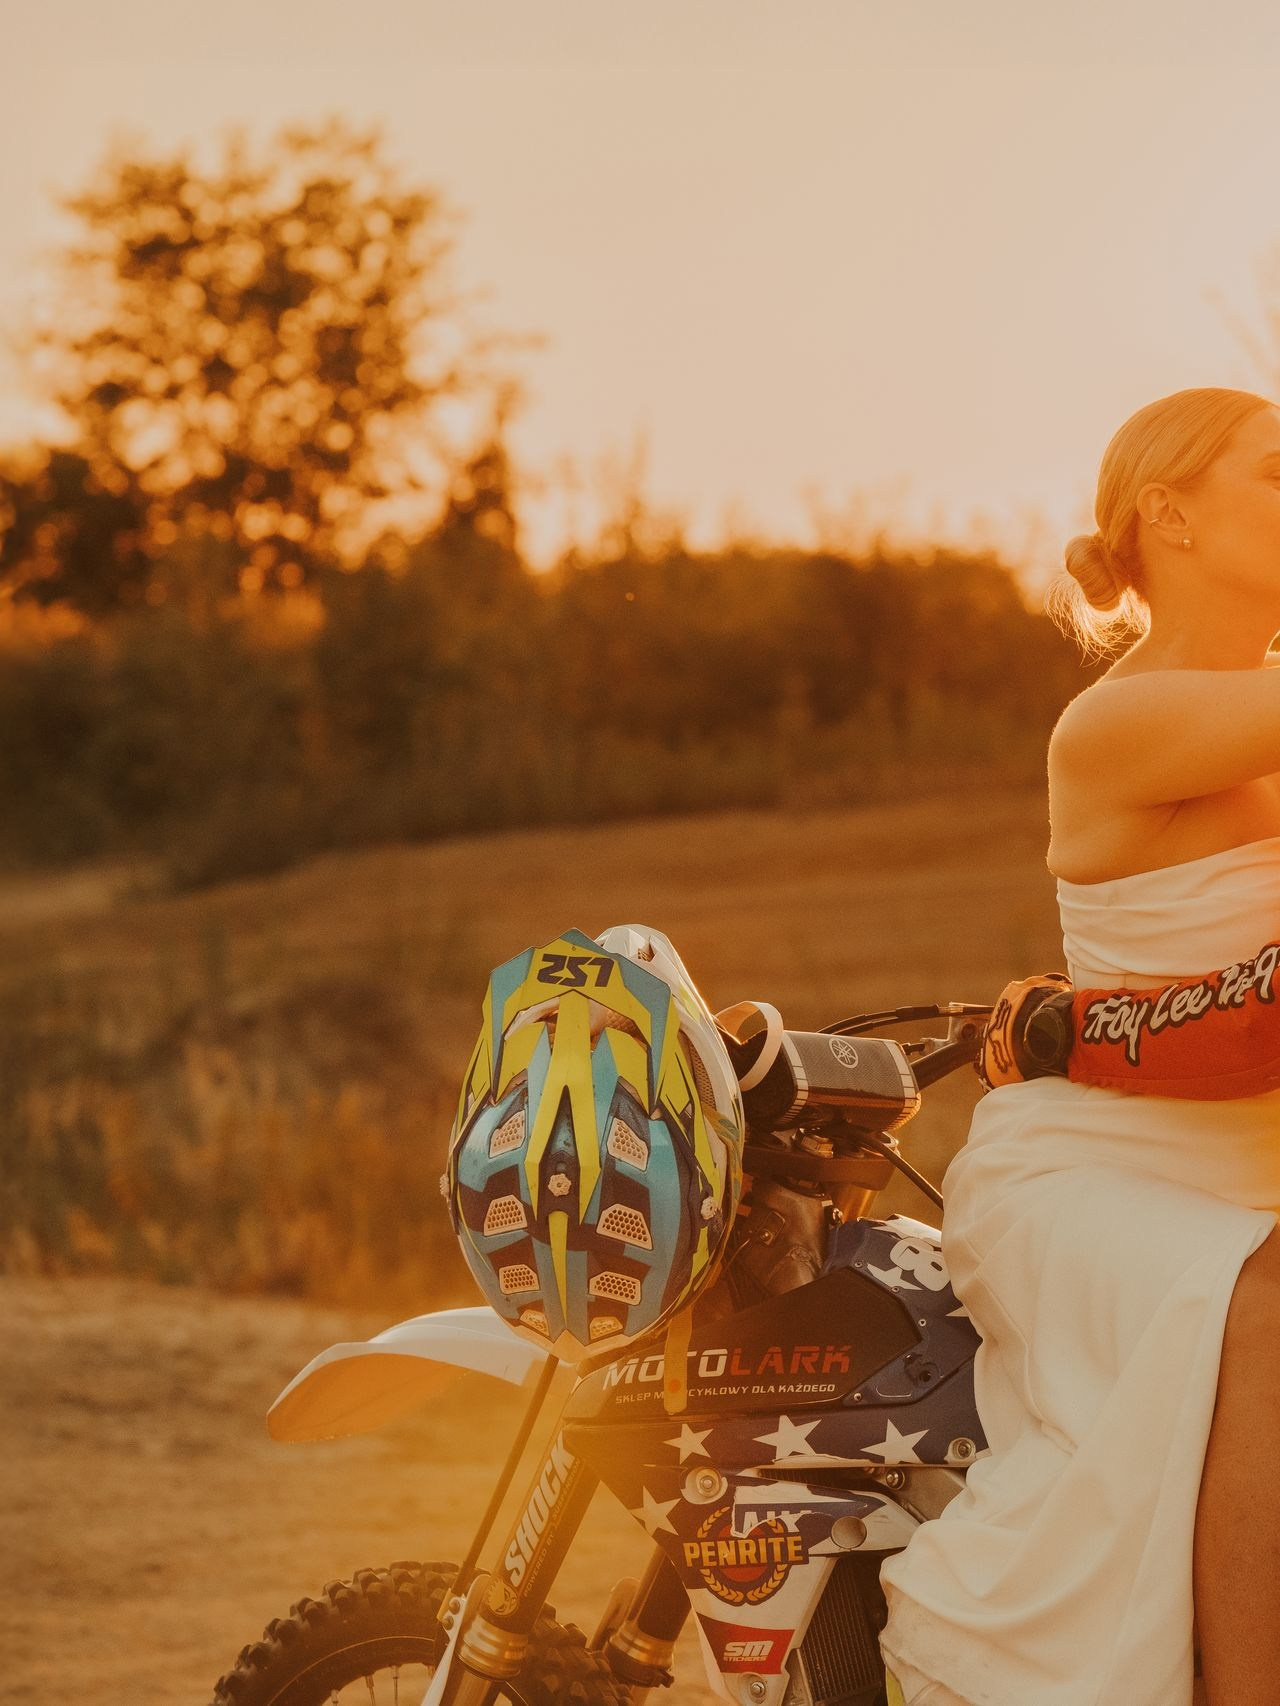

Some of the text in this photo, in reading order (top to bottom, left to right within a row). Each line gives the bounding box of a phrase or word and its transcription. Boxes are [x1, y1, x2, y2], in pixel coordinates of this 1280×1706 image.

[536, 953, 615, 988] 257
[1149, 985, 1213, 1030] Lee
[602, 1345, 852, 1391] MOOLARK
[615, 1391, 652, 1405] SKLEP
[751, 1385, 775, 1394] DLA
[504, 1430, 576, 1588] SHOCK
[683, 1535, 804, 1568] PENRITE
